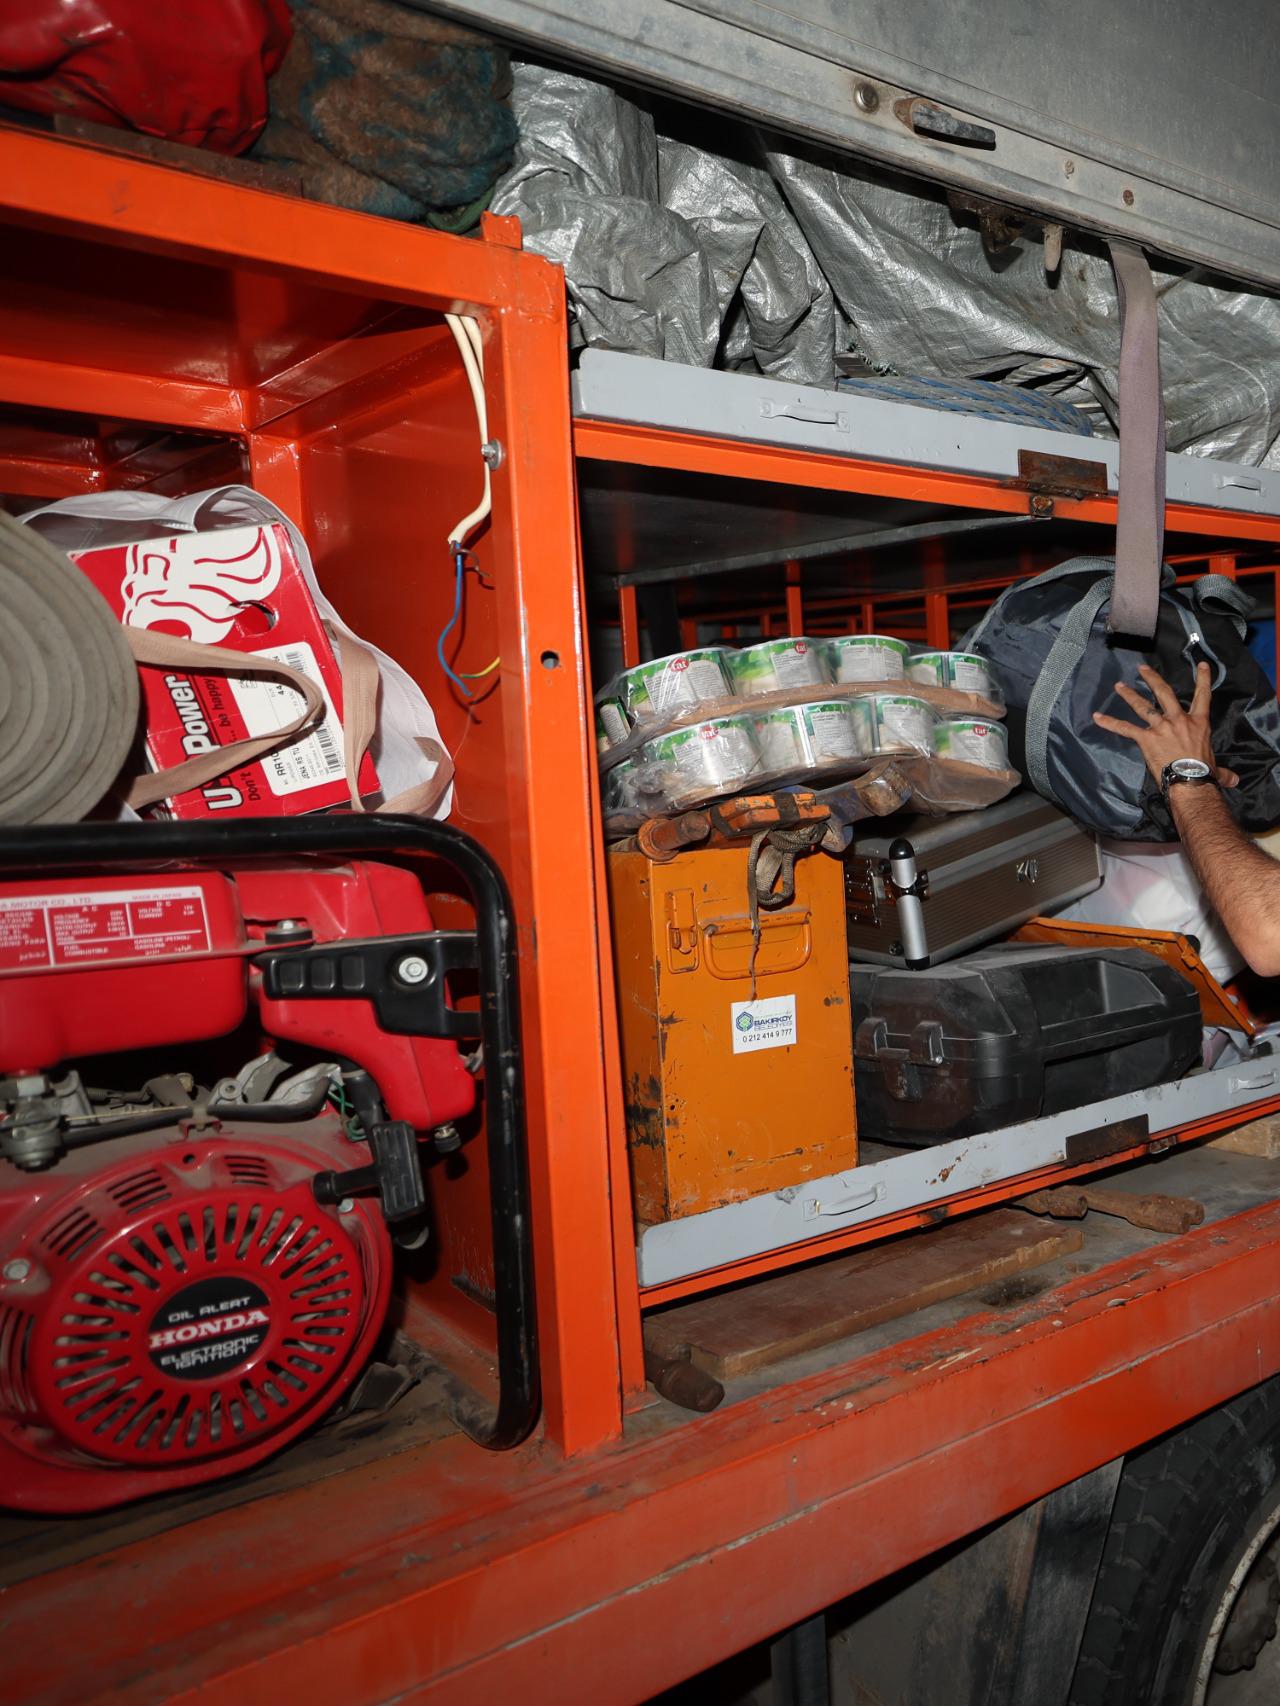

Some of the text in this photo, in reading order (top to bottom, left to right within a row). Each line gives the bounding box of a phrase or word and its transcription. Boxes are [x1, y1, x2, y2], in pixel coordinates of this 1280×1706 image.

[241, 771, 262, 801] Don't
[749, 1034, 761, 1042] 212
[168, 1296, 251, 1323] OIL ALERT
[149, 1310, 269, 1349] HONDA
[160, 1334, 259, 1366] ELECTRONIC
[175, 1345, 247, 1370] IGNITION
